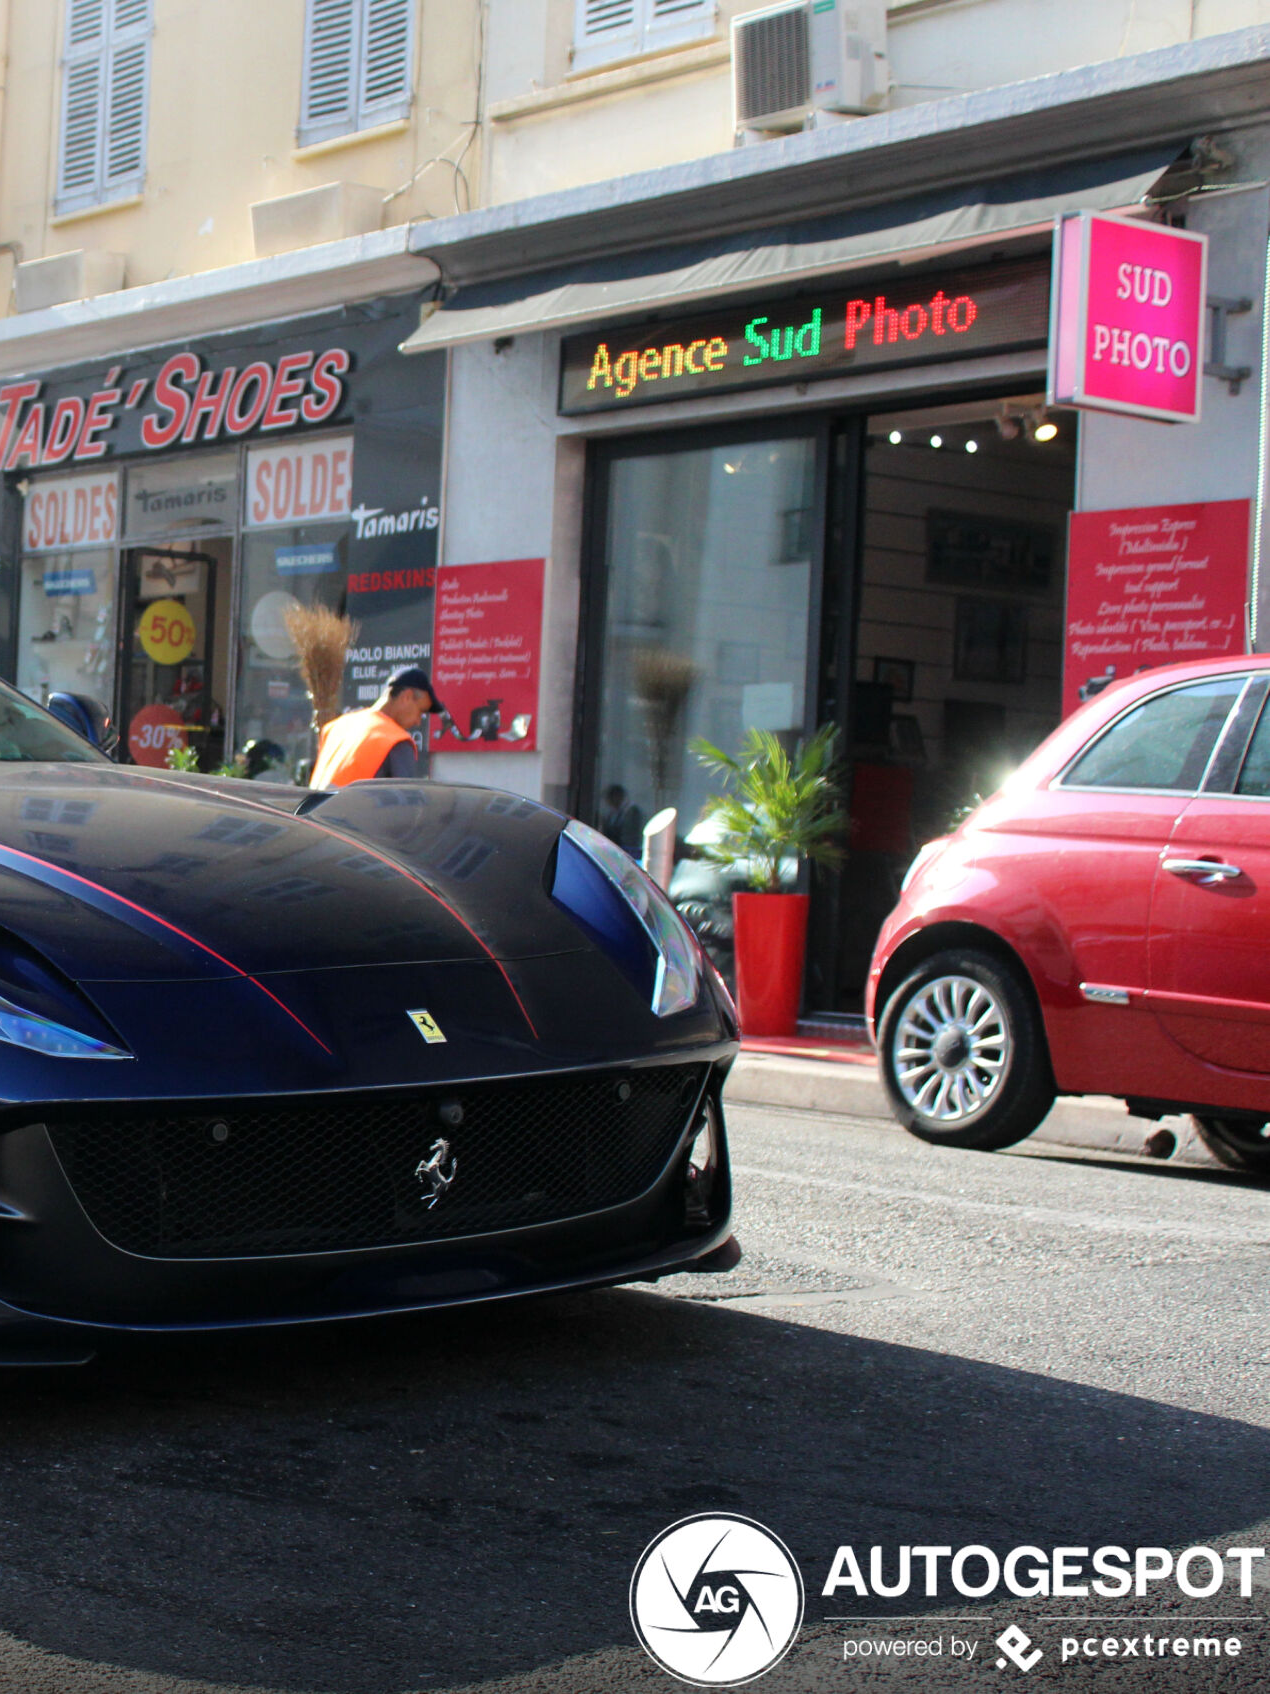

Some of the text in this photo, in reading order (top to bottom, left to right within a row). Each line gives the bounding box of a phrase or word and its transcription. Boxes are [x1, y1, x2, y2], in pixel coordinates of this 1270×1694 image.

[1117, 263, 1172, 307] SUD
[587, 291, 978, 398] Agence Sud Photo
[1093, 324, 1191, 378] PHOTO
[252, 450, 352, 522] SOLDE
[28, 482, 117, 548] SOLDES
[347, 567, 435, 593] REDSKINS
[345, 643, 430, 662] PAOLO BIANCHI
[132, 724, 184, 749] -30%
